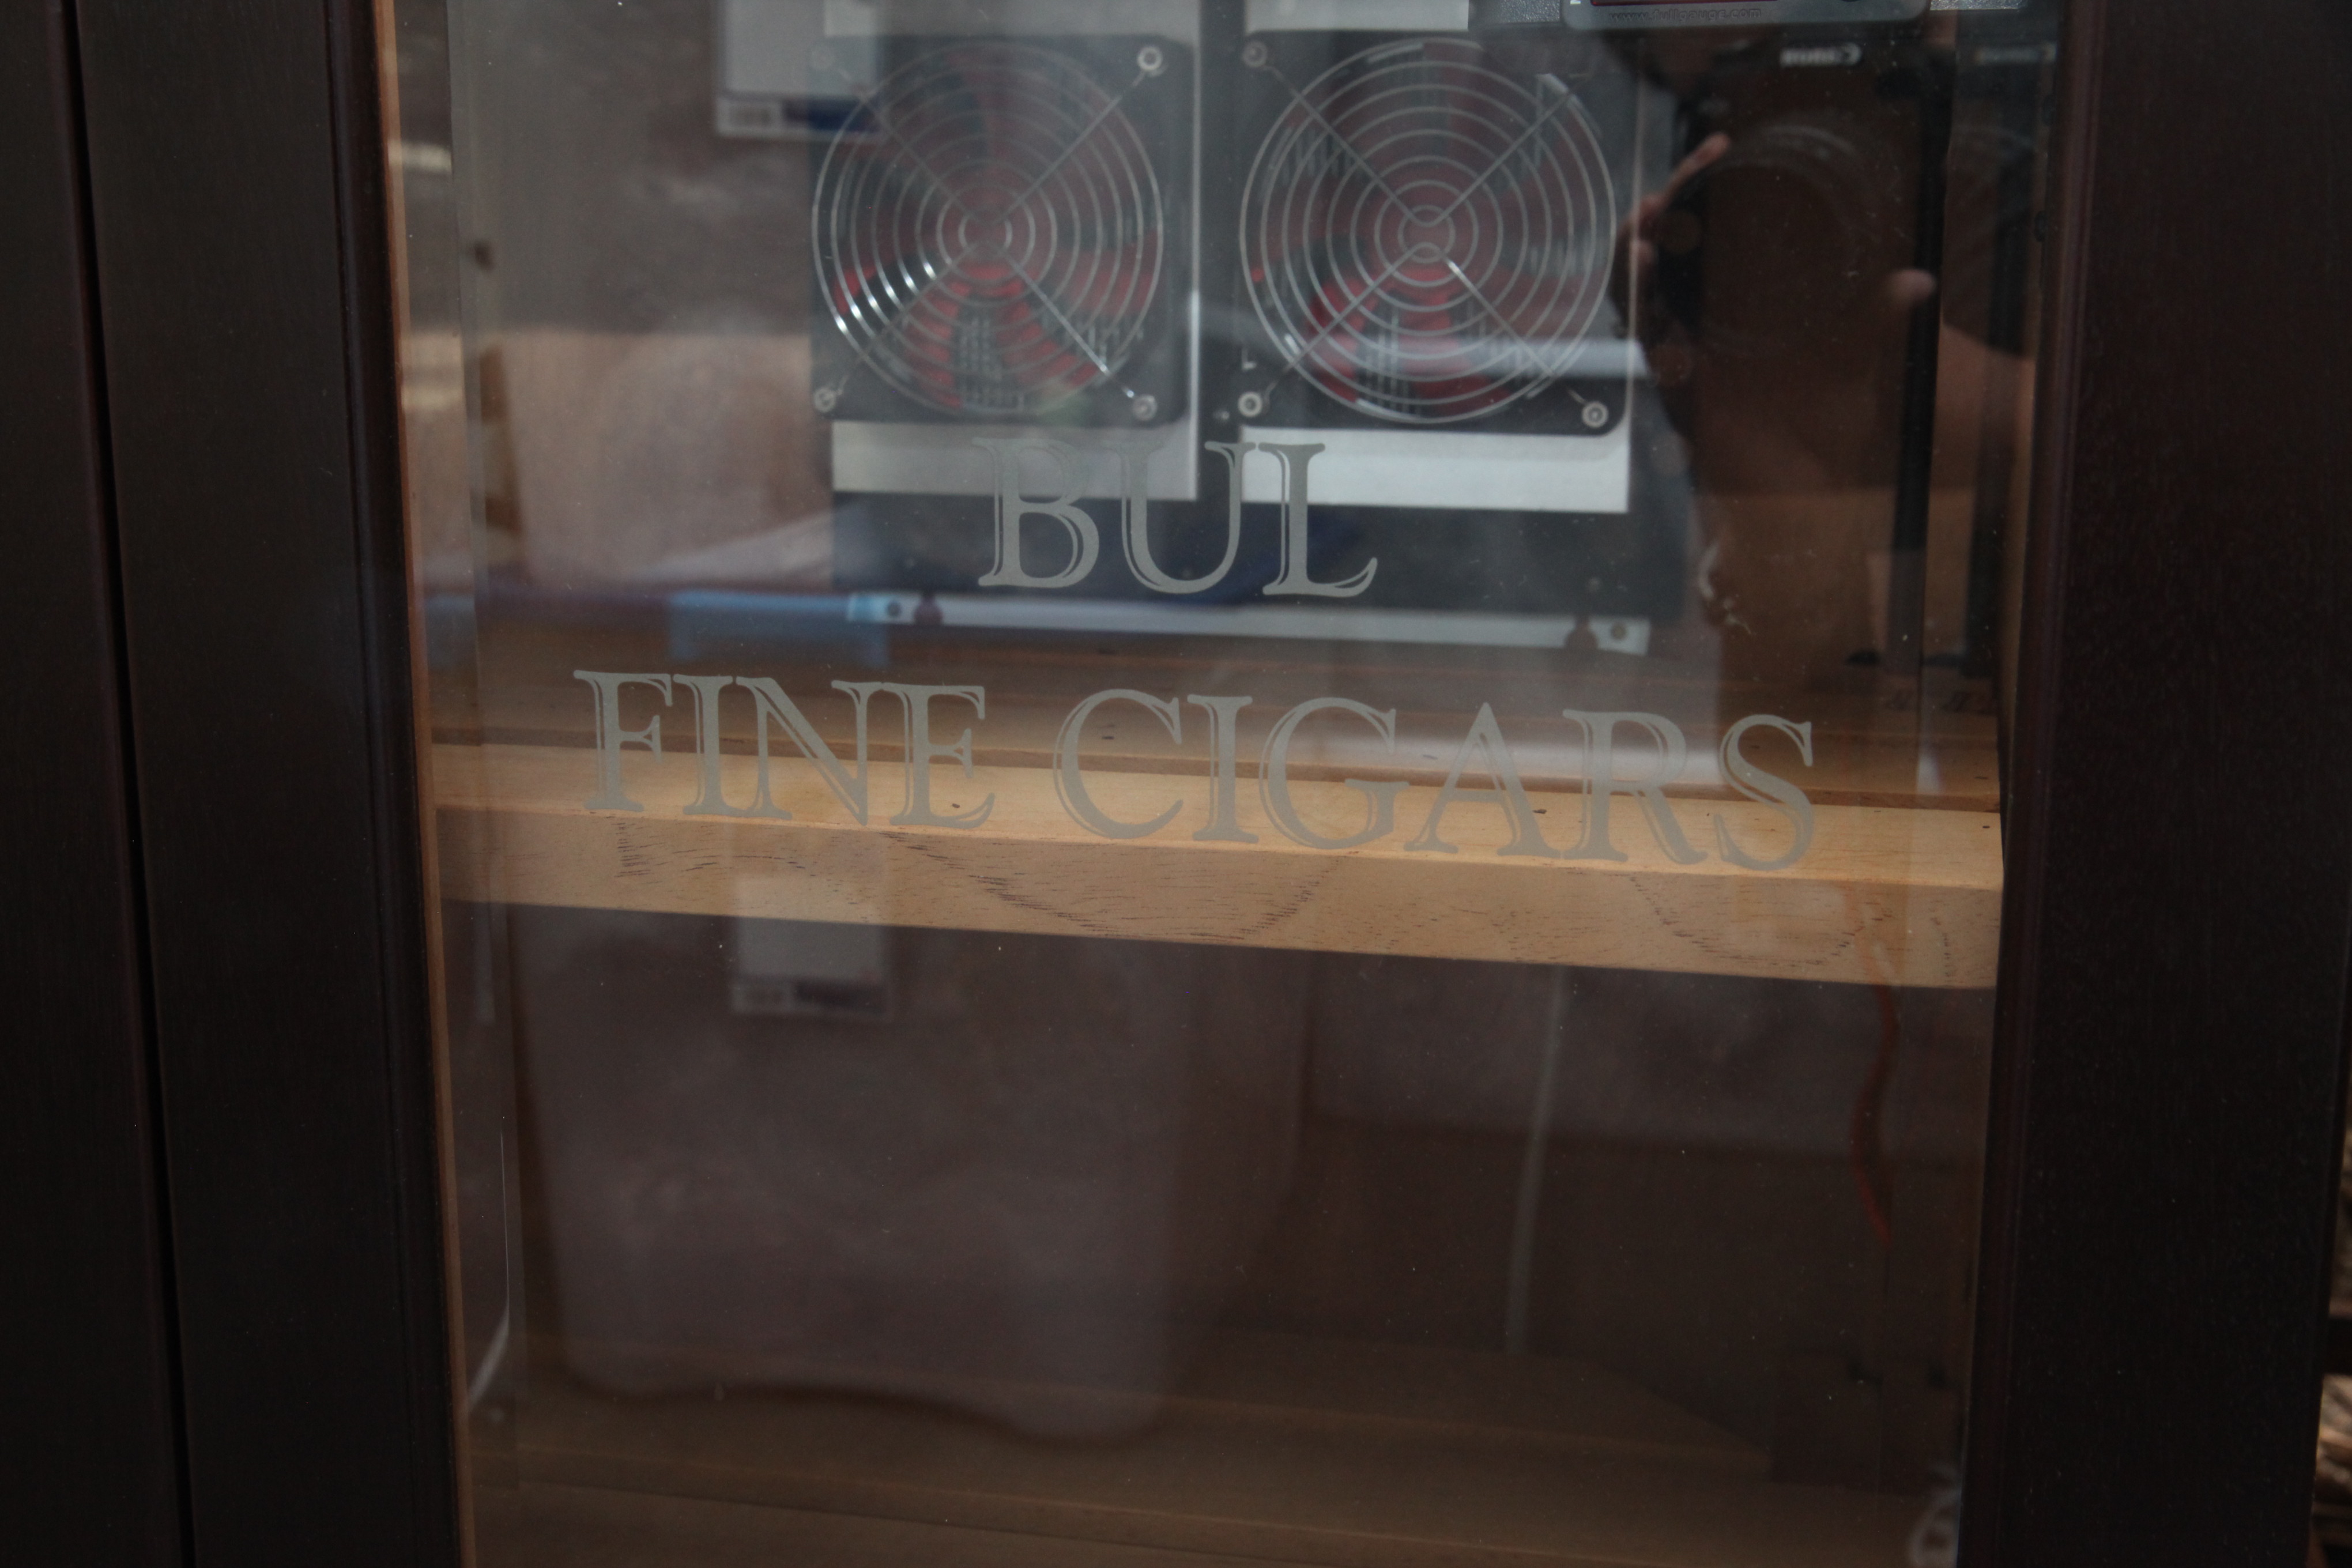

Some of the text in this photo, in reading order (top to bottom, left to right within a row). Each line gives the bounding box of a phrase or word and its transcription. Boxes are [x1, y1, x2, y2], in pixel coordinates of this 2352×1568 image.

[1608, 7, 1762, 22] www.fullgauge.com
[973, 437, 1378, 597] BUL
[574, 669, 1816, 871] FINE CIGARS
